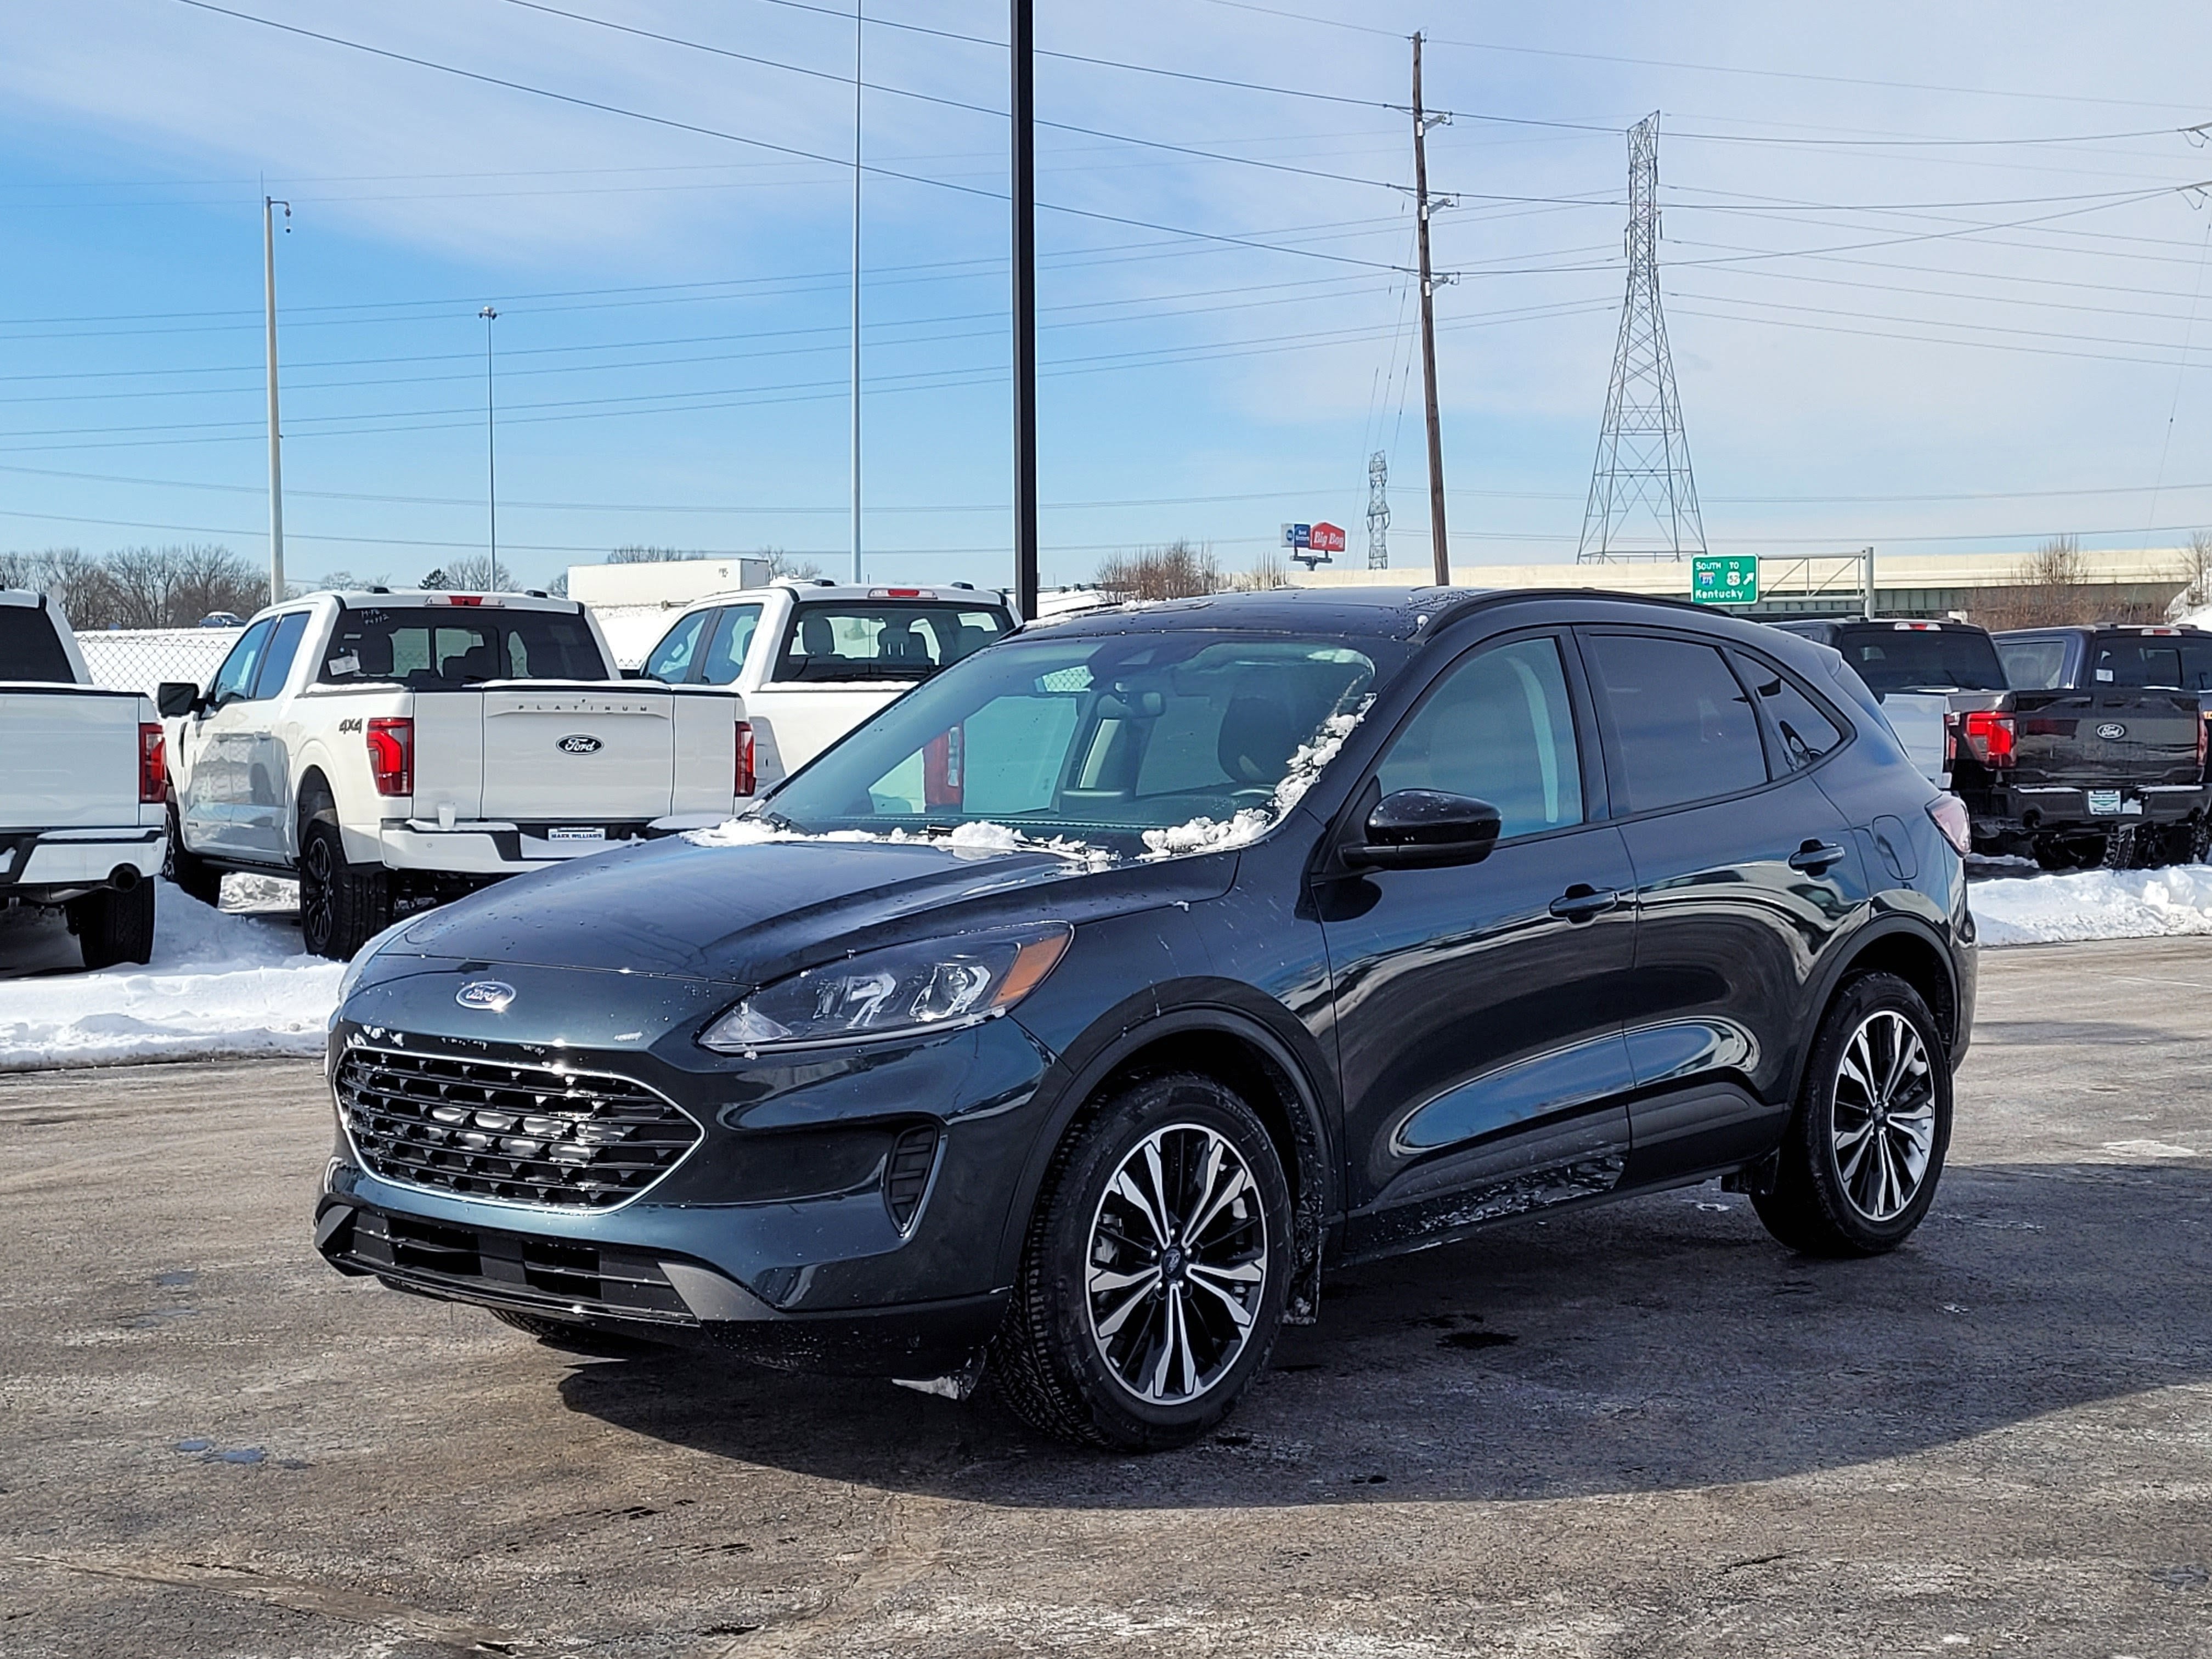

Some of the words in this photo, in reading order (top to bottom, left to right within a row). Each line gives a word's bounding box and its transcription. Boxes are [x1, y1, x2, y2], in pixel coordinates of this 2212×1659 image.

[1313, 531, 1328, 546] Big
[1328, 532, 1344, 549] Boy
[1696, 561, 1722, 571] SOUTH
[1729, 561, 1739, 569] TO
[1696, 589, 1743, 600] Kentucky
[565, 738, 596, 751] Ford
[466, 985, 502, 1001] Ford
